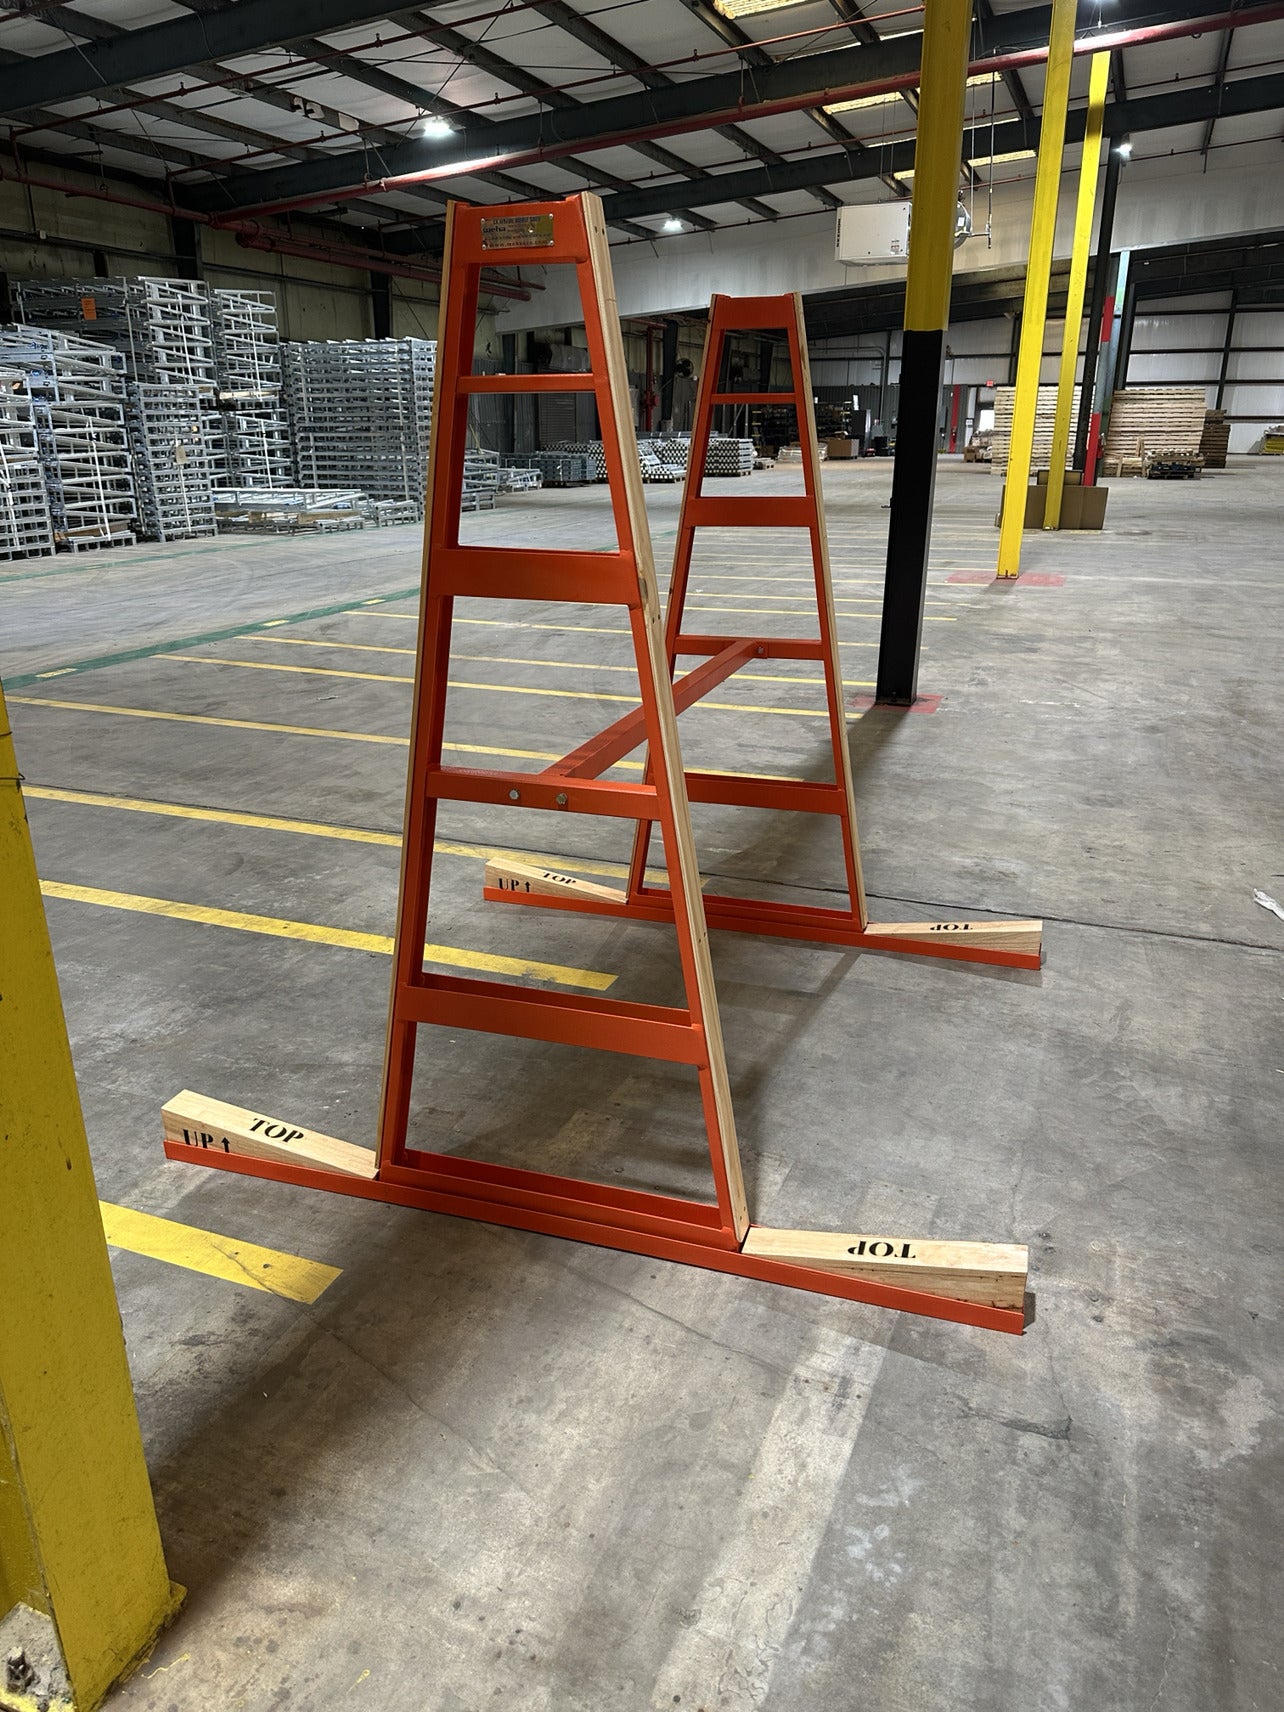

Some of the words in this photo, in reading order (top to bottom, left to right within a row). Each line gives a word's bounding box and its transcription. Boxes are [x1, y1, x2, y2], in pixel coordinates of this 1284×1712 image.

[498, 878, 520, 891] UP
[542, 872, 577, 885] TOP
[930, 923, 974, 931] TOP
[183, 1129, 213, 1148] UP
[249, 1118, 304, 1143] TOP
[847, 1240, 917, 1259] TOP
